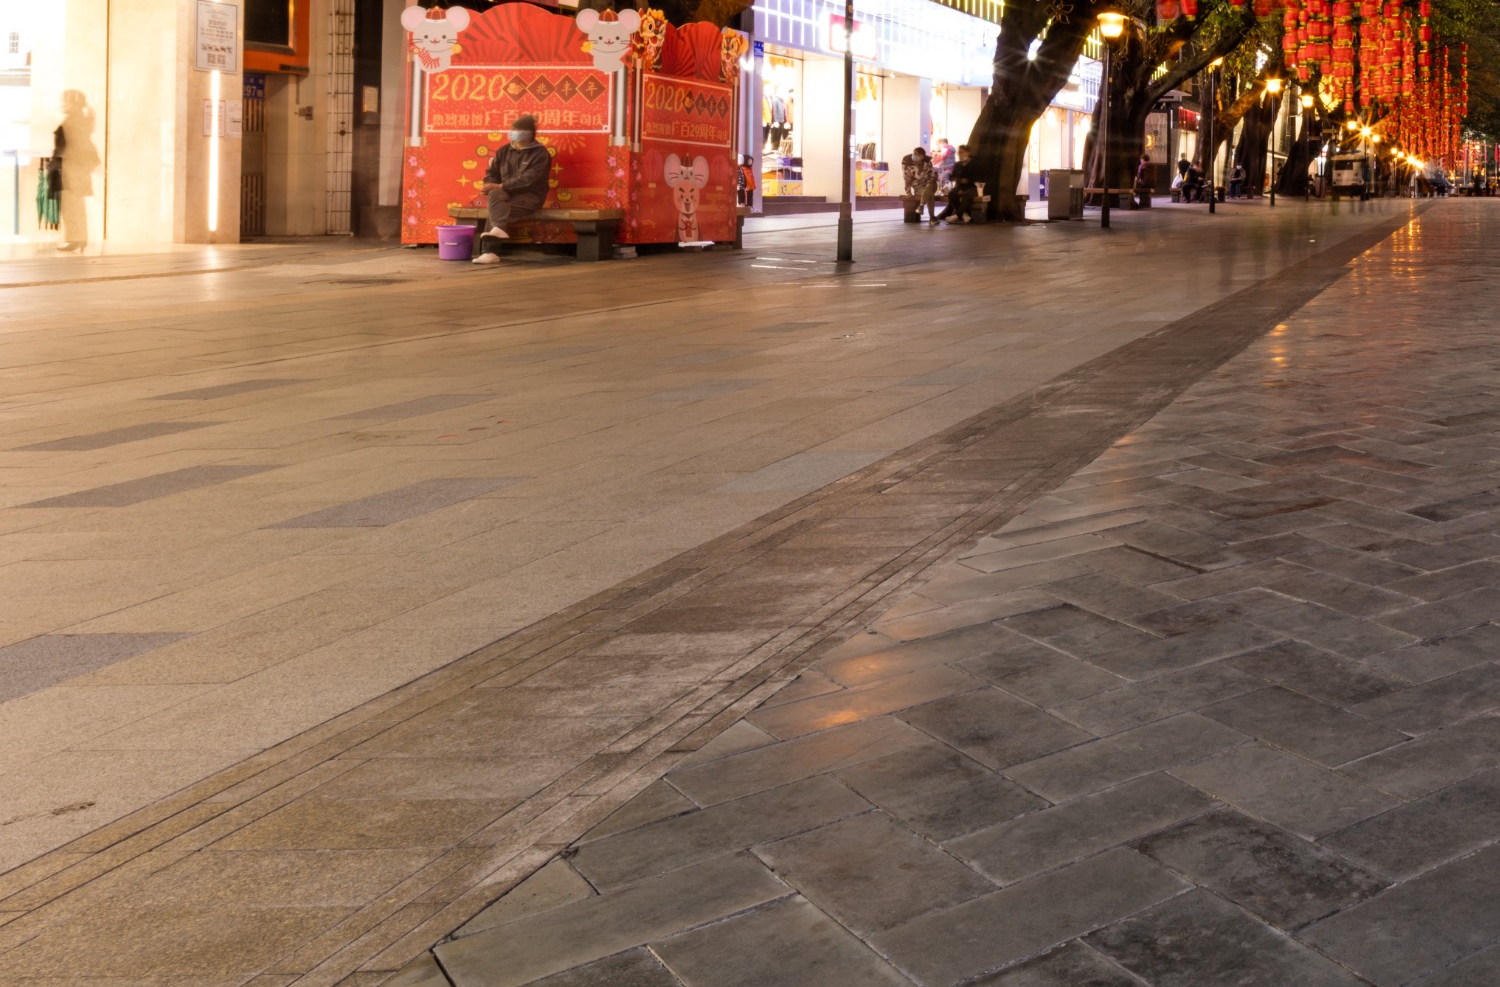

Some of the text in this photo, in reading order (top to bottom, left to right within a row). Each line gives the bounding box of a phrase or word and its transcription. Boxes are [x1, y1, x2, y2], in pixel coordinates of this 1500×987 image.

[432, 73, 598, 101] 2020 兆丰年
[645, 82, 685, 112] 2020
